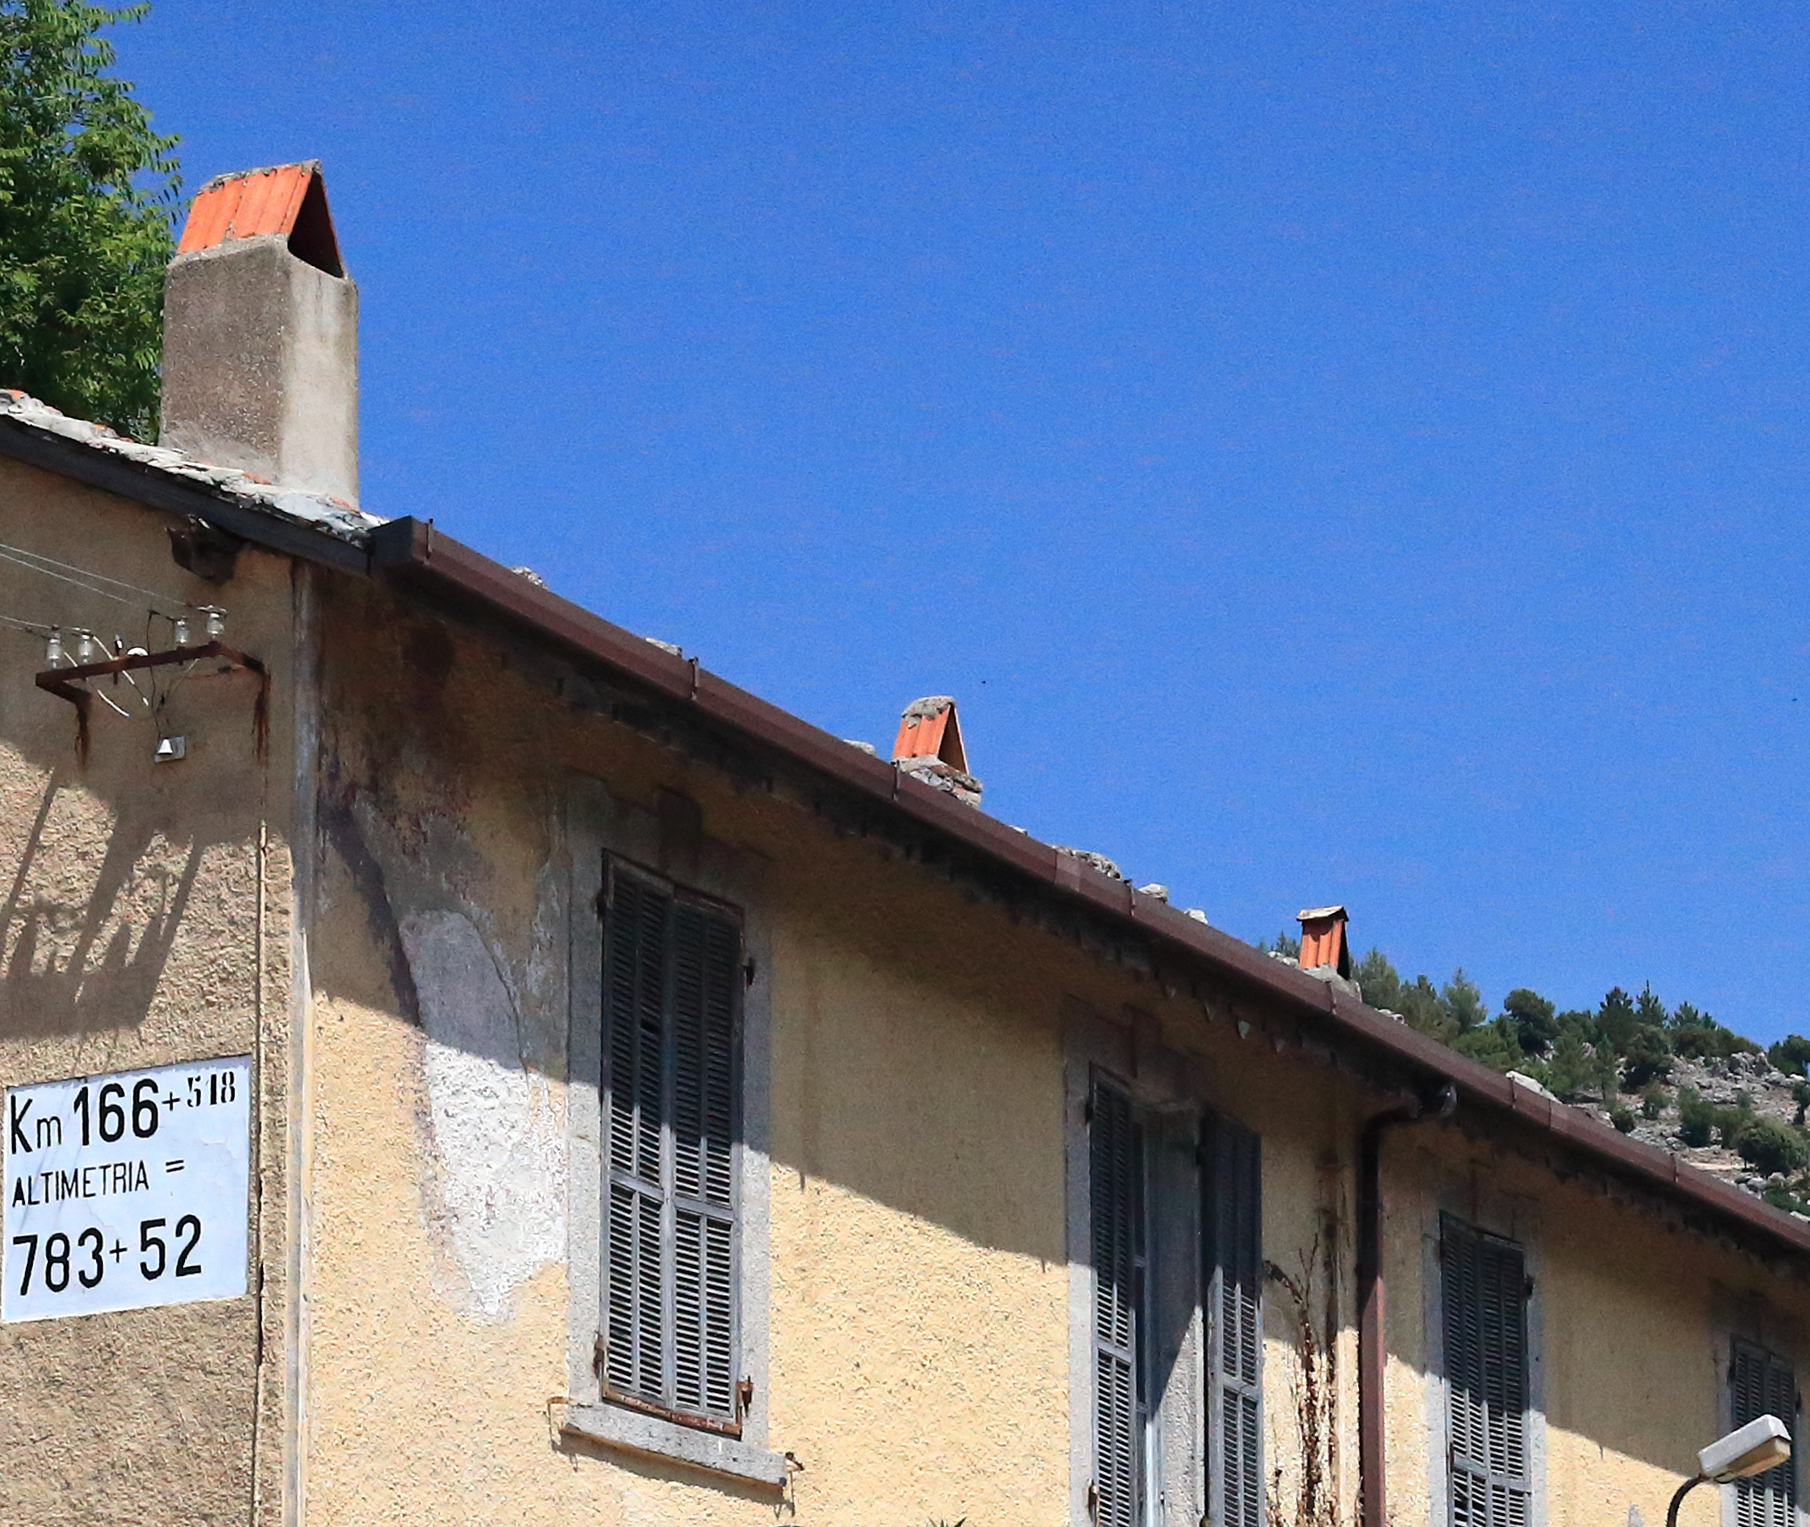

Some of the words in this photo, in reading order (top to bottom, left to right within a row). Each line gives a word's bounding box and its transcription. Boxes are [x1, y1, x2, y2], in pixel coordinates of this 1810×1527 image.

[10, 1095, 62, 1154] Km
[12, 1160, 149, 1208] ALTIMETRIA
[12, 1214, 202, 1296] 783+52
